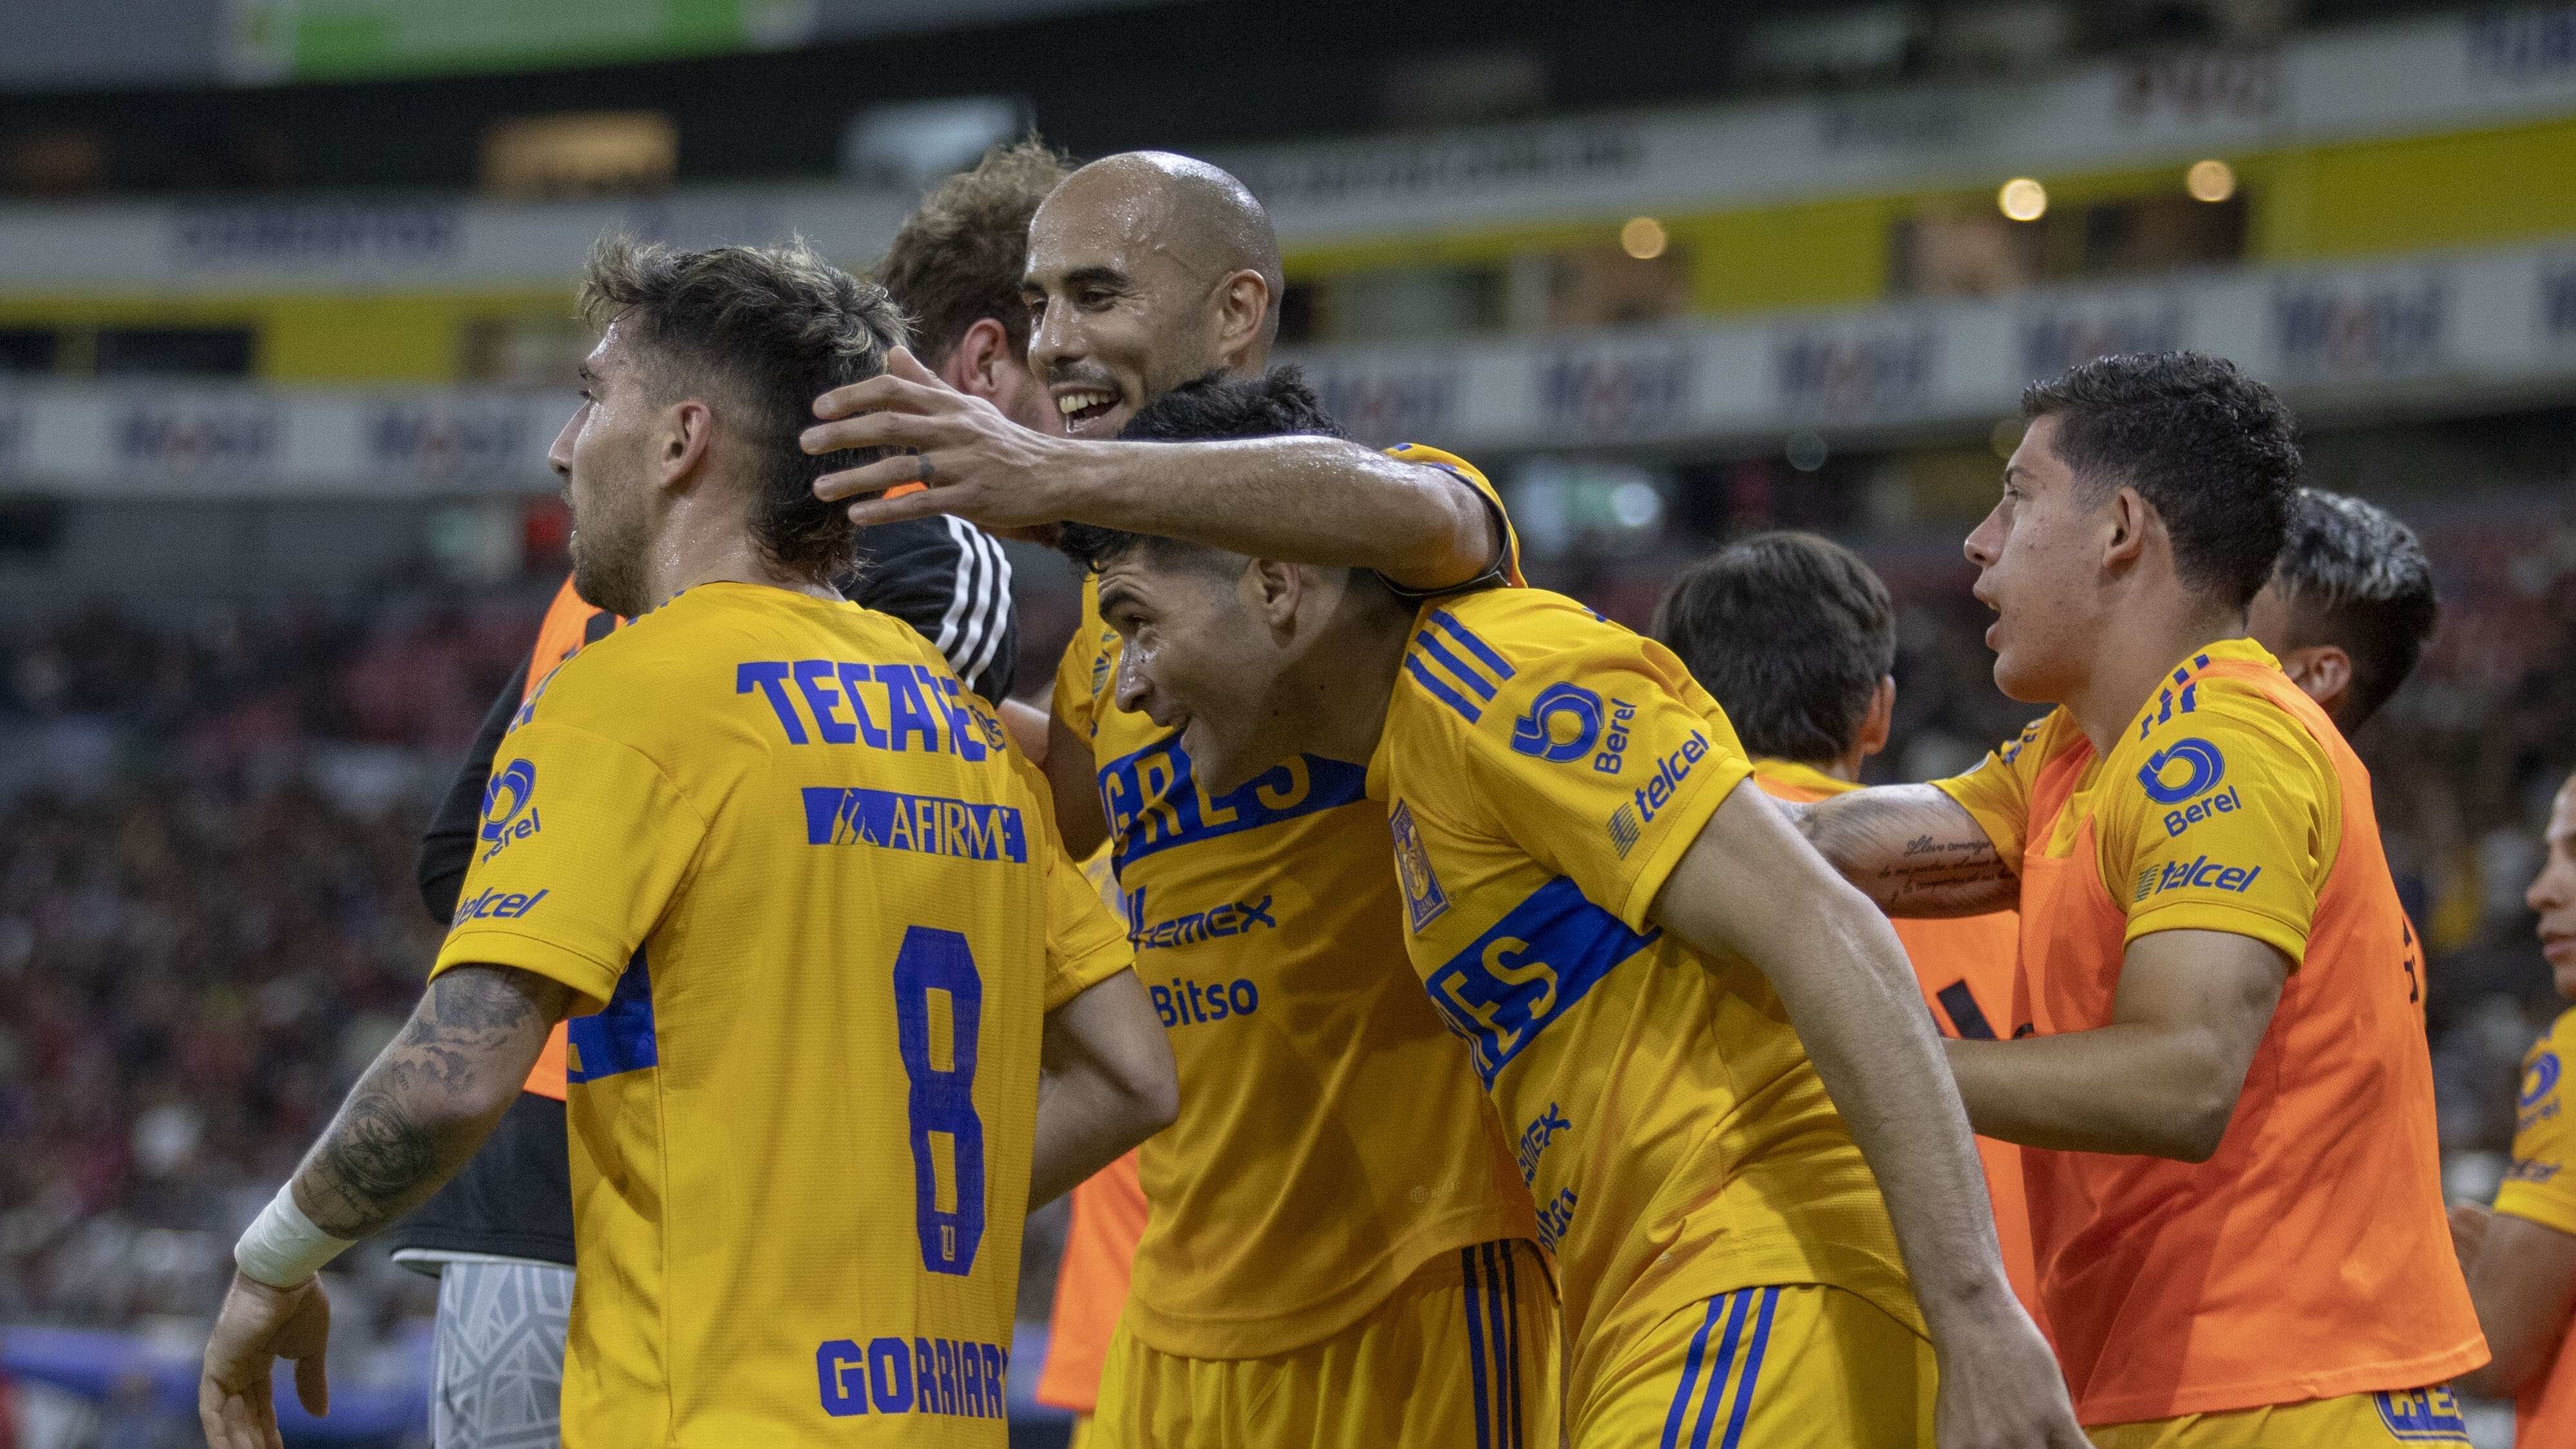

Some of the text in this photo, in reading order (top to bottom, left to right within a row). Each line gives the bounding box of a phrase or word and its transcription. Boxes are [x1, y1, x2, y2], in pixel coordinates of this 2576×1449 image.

[736, 660, 986, 762] TECATE
[1593, 697, 1636, 775] Berel
[1634, 729, 1710, 823] telcel
[2164, 785, 2241, 837] Berel
[482, 807, 541, 864] erel
[2155, 855, 2261, 895] telcel
[1150, 978, 1259, 1028] Bitso
[893, 925, 985, 1276] 8
[816, 1337, 1009, 1420] GORRIAR
